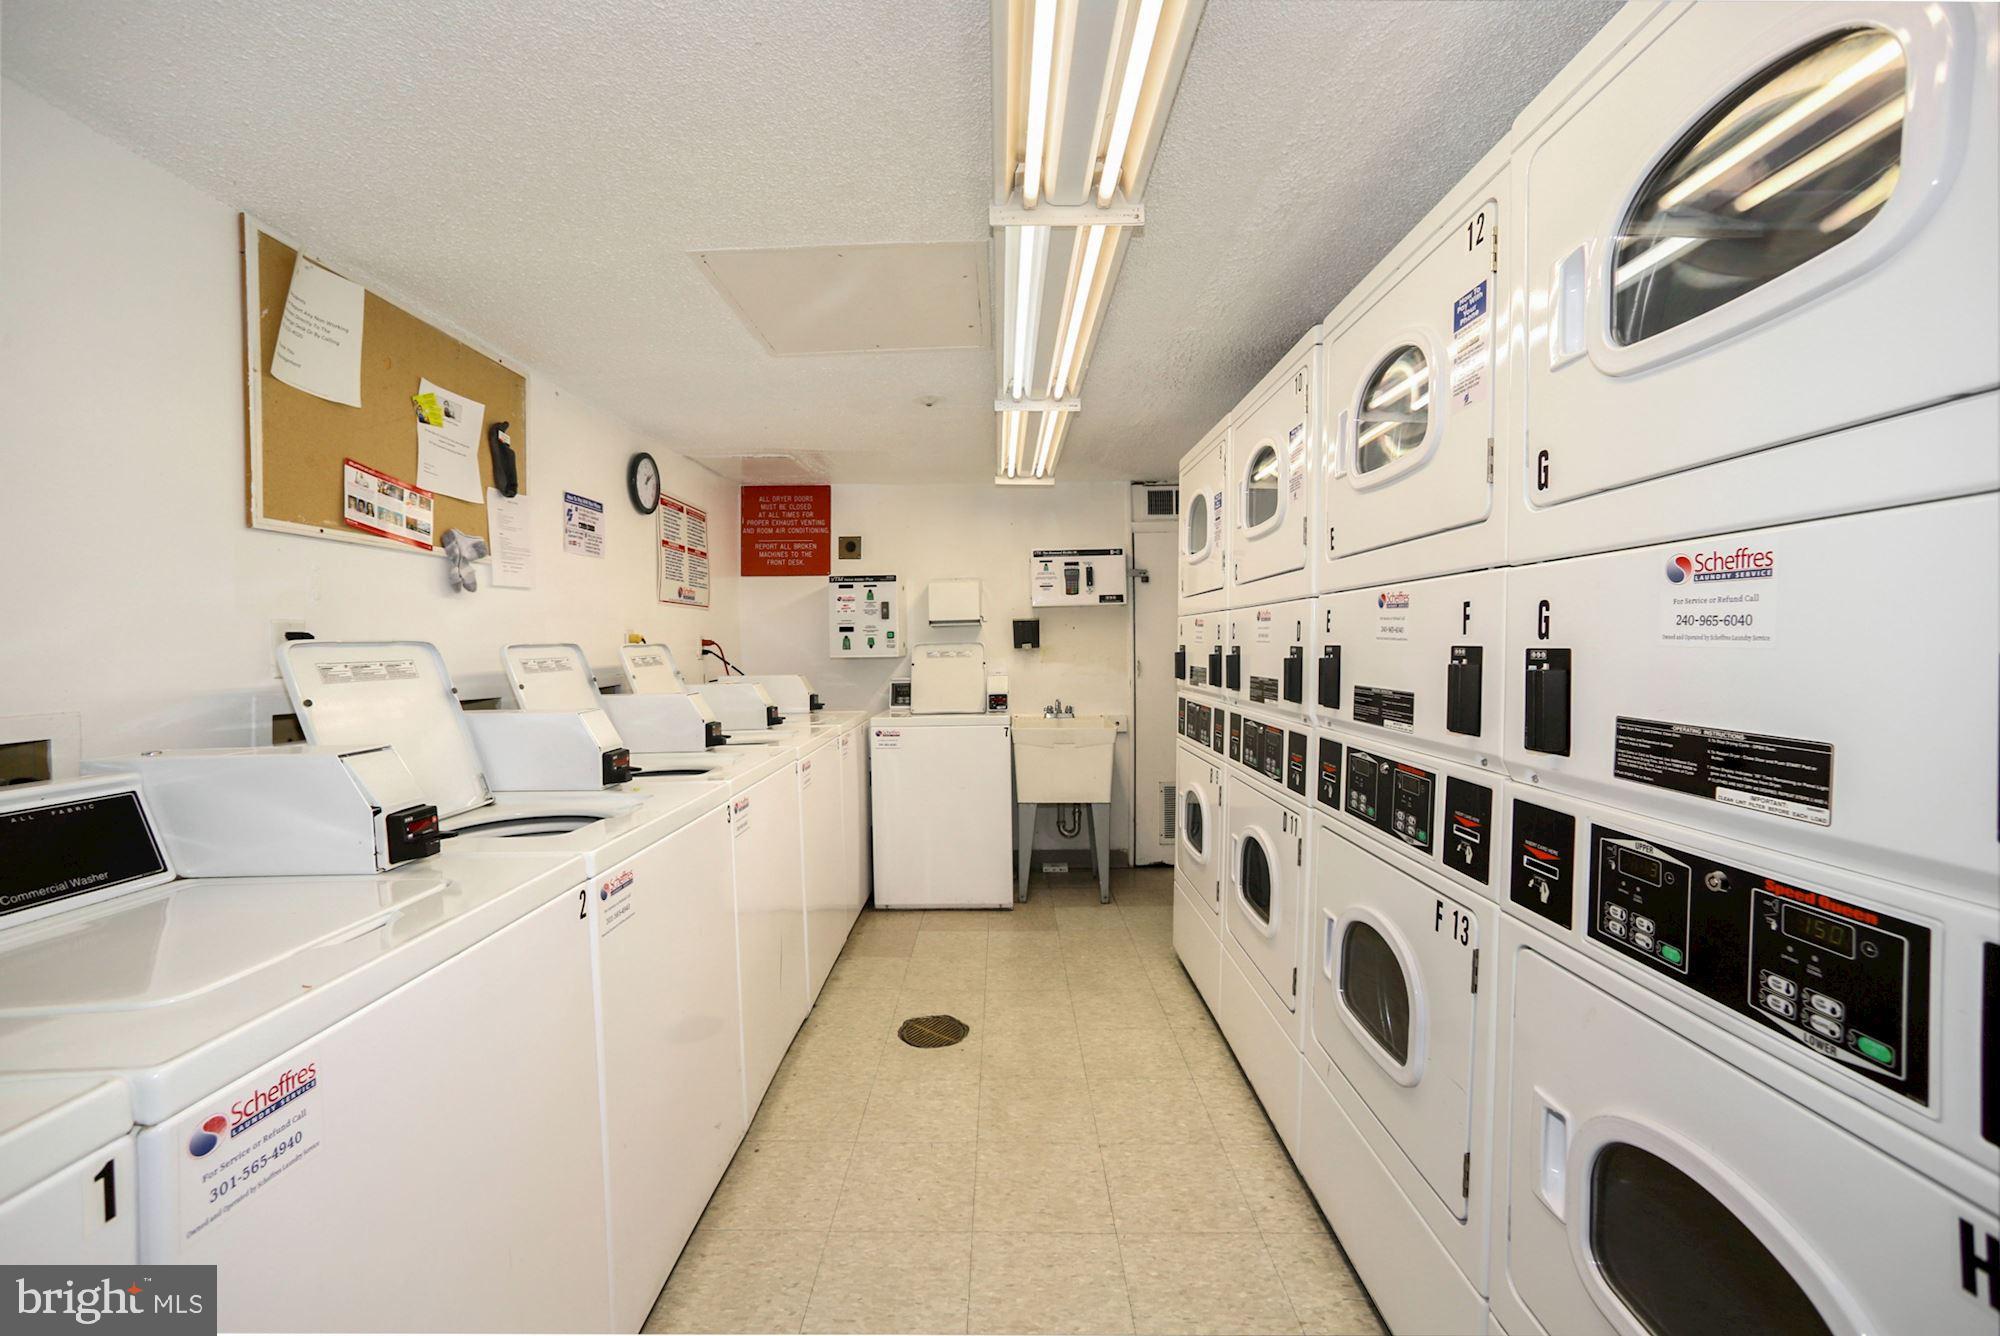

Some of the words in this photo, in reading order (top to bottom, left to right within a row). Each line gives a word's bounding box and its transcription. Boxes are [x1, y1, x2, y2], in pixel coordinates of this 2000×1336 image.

[1467, 212, 1485, 252] 12
[1456, 302, 1468, 314] Pay
[1469, 292, 1484, 305] With
[1458, 292, 1473, 306] How
[1473, 286, 1482, 296] To
[1460, 310, 1480, 326] Phone
[1462, 304, 1477, 317] Your
[1538, 450, 1549, 491] G
[1330, 527, 1335, 550] E
[1694, 548, 1774, 572] Scheffres
[1694, 573, 1732, 581] LAUNDRY
[1735, 569, 1772, 578] SERVICE
[1717, 594, 1744, 603] Refund
[1744, 594, 1760, 602] Call
[1326, 610, 1331, 632] E
[1463, 601, 1471, 635] F
[1538, 599, 1550, 640] G
[1676, 614, 1753, 626] 240-965-6040
[1004, 727, 1009, 738] 7
[1672, 725, 1702, 736] OPERATING
[1704, 730, 1744, 740] INSTRUCTIONS
[51, 803, 95, 816] FABRIC
[1768, 806, 1789, 815] BEFORE
[1635, 842, 1654, 854] UPPER
[0, 880, 69, 906] Commercial
[69, 872, 110, 888] Washer
[579, 890, 586, 920] 2
[1764, 879, 1815, 905] Speed
[1818, 896, 1878, 926] Queen
[1435, 900, 1443, 932] F
[1453, 910, 1469, 946] 13
[1804, 1032, 1837, 1056] LOWER
[230, 1062, 316, 1126] Scheffres
[232, 1105, 279, 1137] LAUNDRY
[280, 1080, 316, 1104] SERVICE
[202, 1170, 218, 1184] For
[220, 1148, 250, 1172] Service
[252, 1140, 262, 1150] or
[262, 1120, 292, 1144] Refund
[292, 1108, 307, 1126] Call
[209, 1130, 303, 1204] 301-565-4940
[94, 1158, 117, 1223] 1
[186, 1223, 209, 1238] Owned
[210, 1210, 222, 1224] and
[222, 1192, 250, 1214] Operated
[250, 1185, 257, 1196] by
[282, 1154, 303, 1174] Laundry
[1959, 1216, 2000, 1313] H
